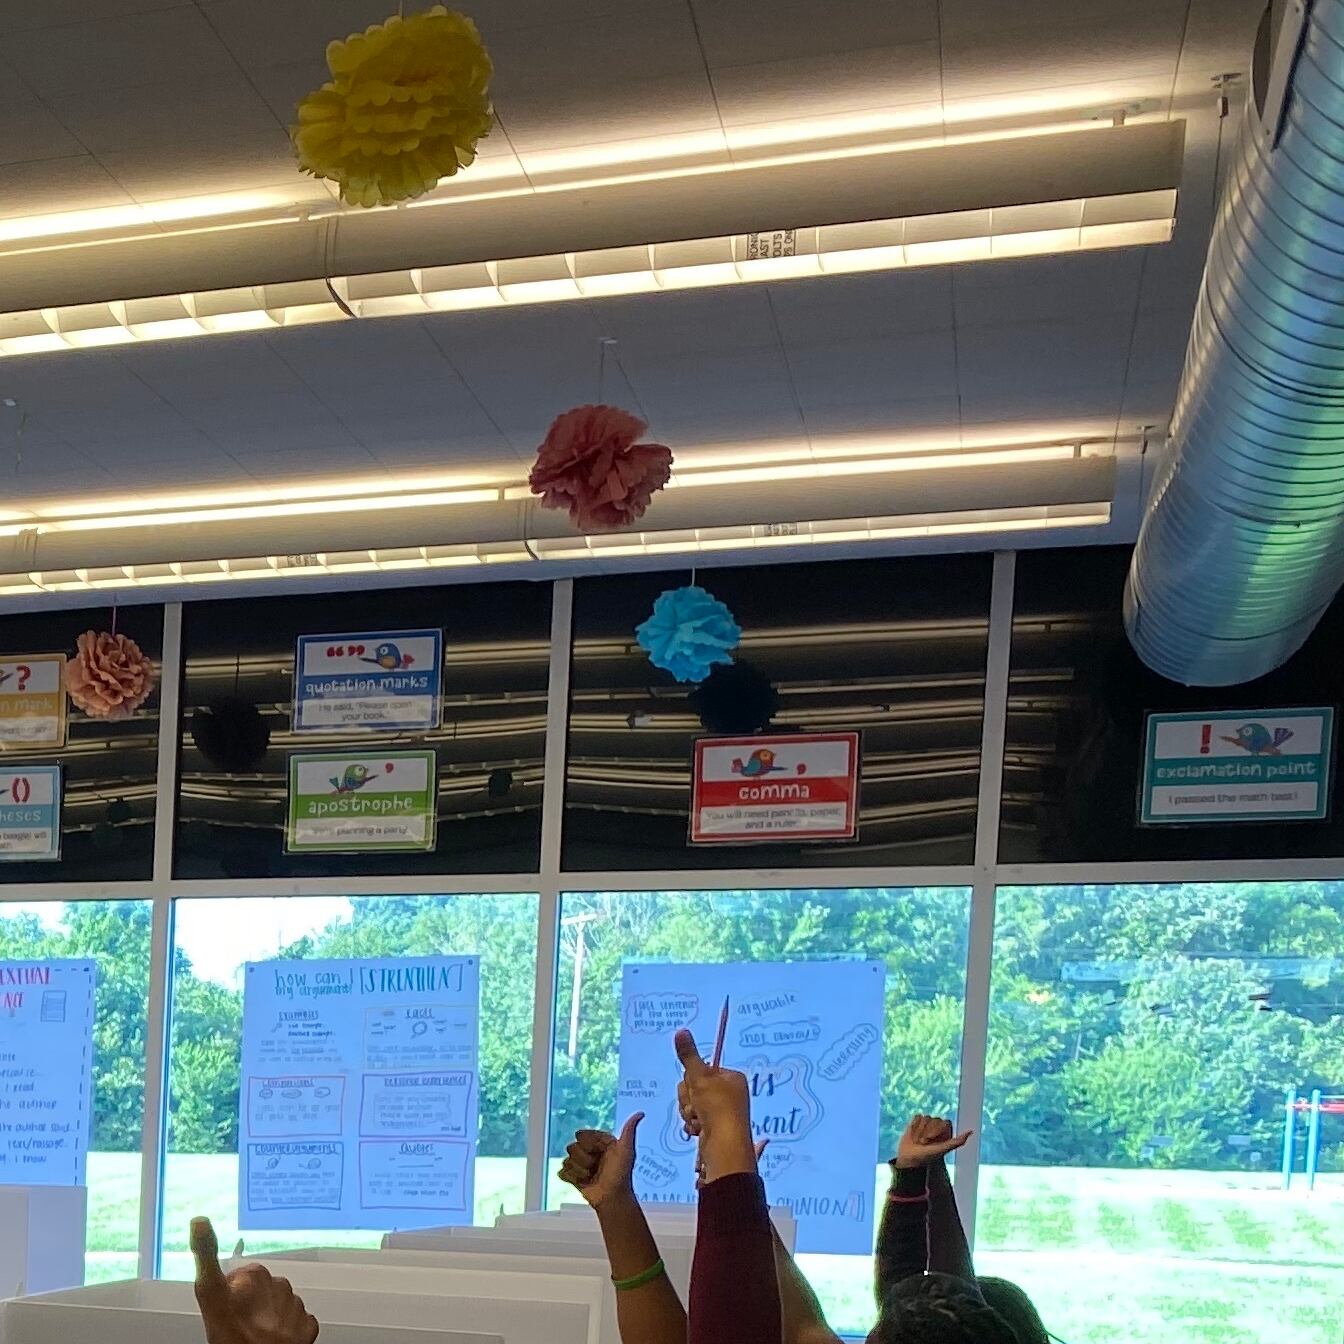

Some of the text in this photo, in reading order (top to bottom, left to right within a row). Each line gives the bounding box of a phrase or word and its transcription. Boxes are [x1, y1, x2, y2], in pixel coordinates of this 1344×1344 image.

[305, 676, 428, 697] quotation marks
[1156, 762, 1316, 778] exclamation point
[739, 784, 810, 800] comma
[308, 795, 412, 817] apostrophe
